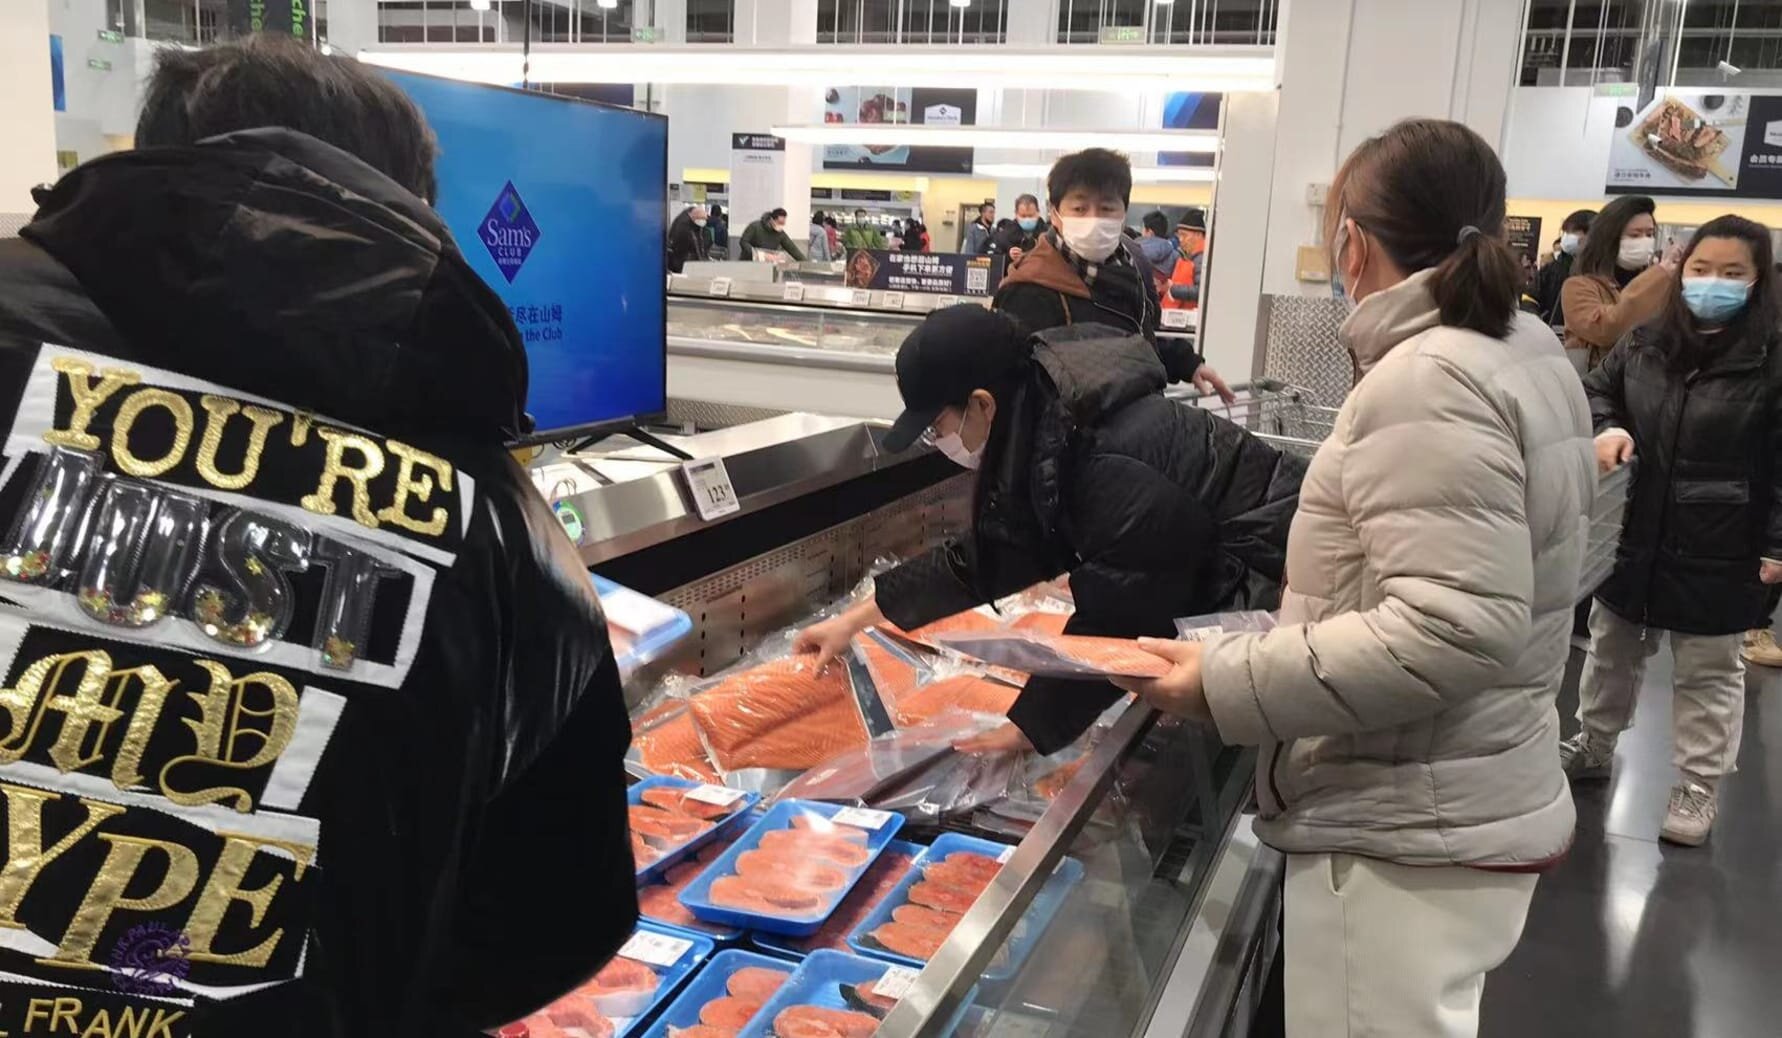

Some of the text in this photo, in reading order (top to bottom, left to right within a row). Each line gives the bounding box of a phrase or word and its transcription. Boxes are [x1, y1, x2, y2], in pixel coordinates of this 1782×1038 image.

[487, 218, 532, 248] Sam's
[511, 303, 562, 325] 尽在山姆
[542, 326, 562, 340] Club
[42, 356, 453, 537] YOU'RE
[24, 997, 187, 1038] FRANK
